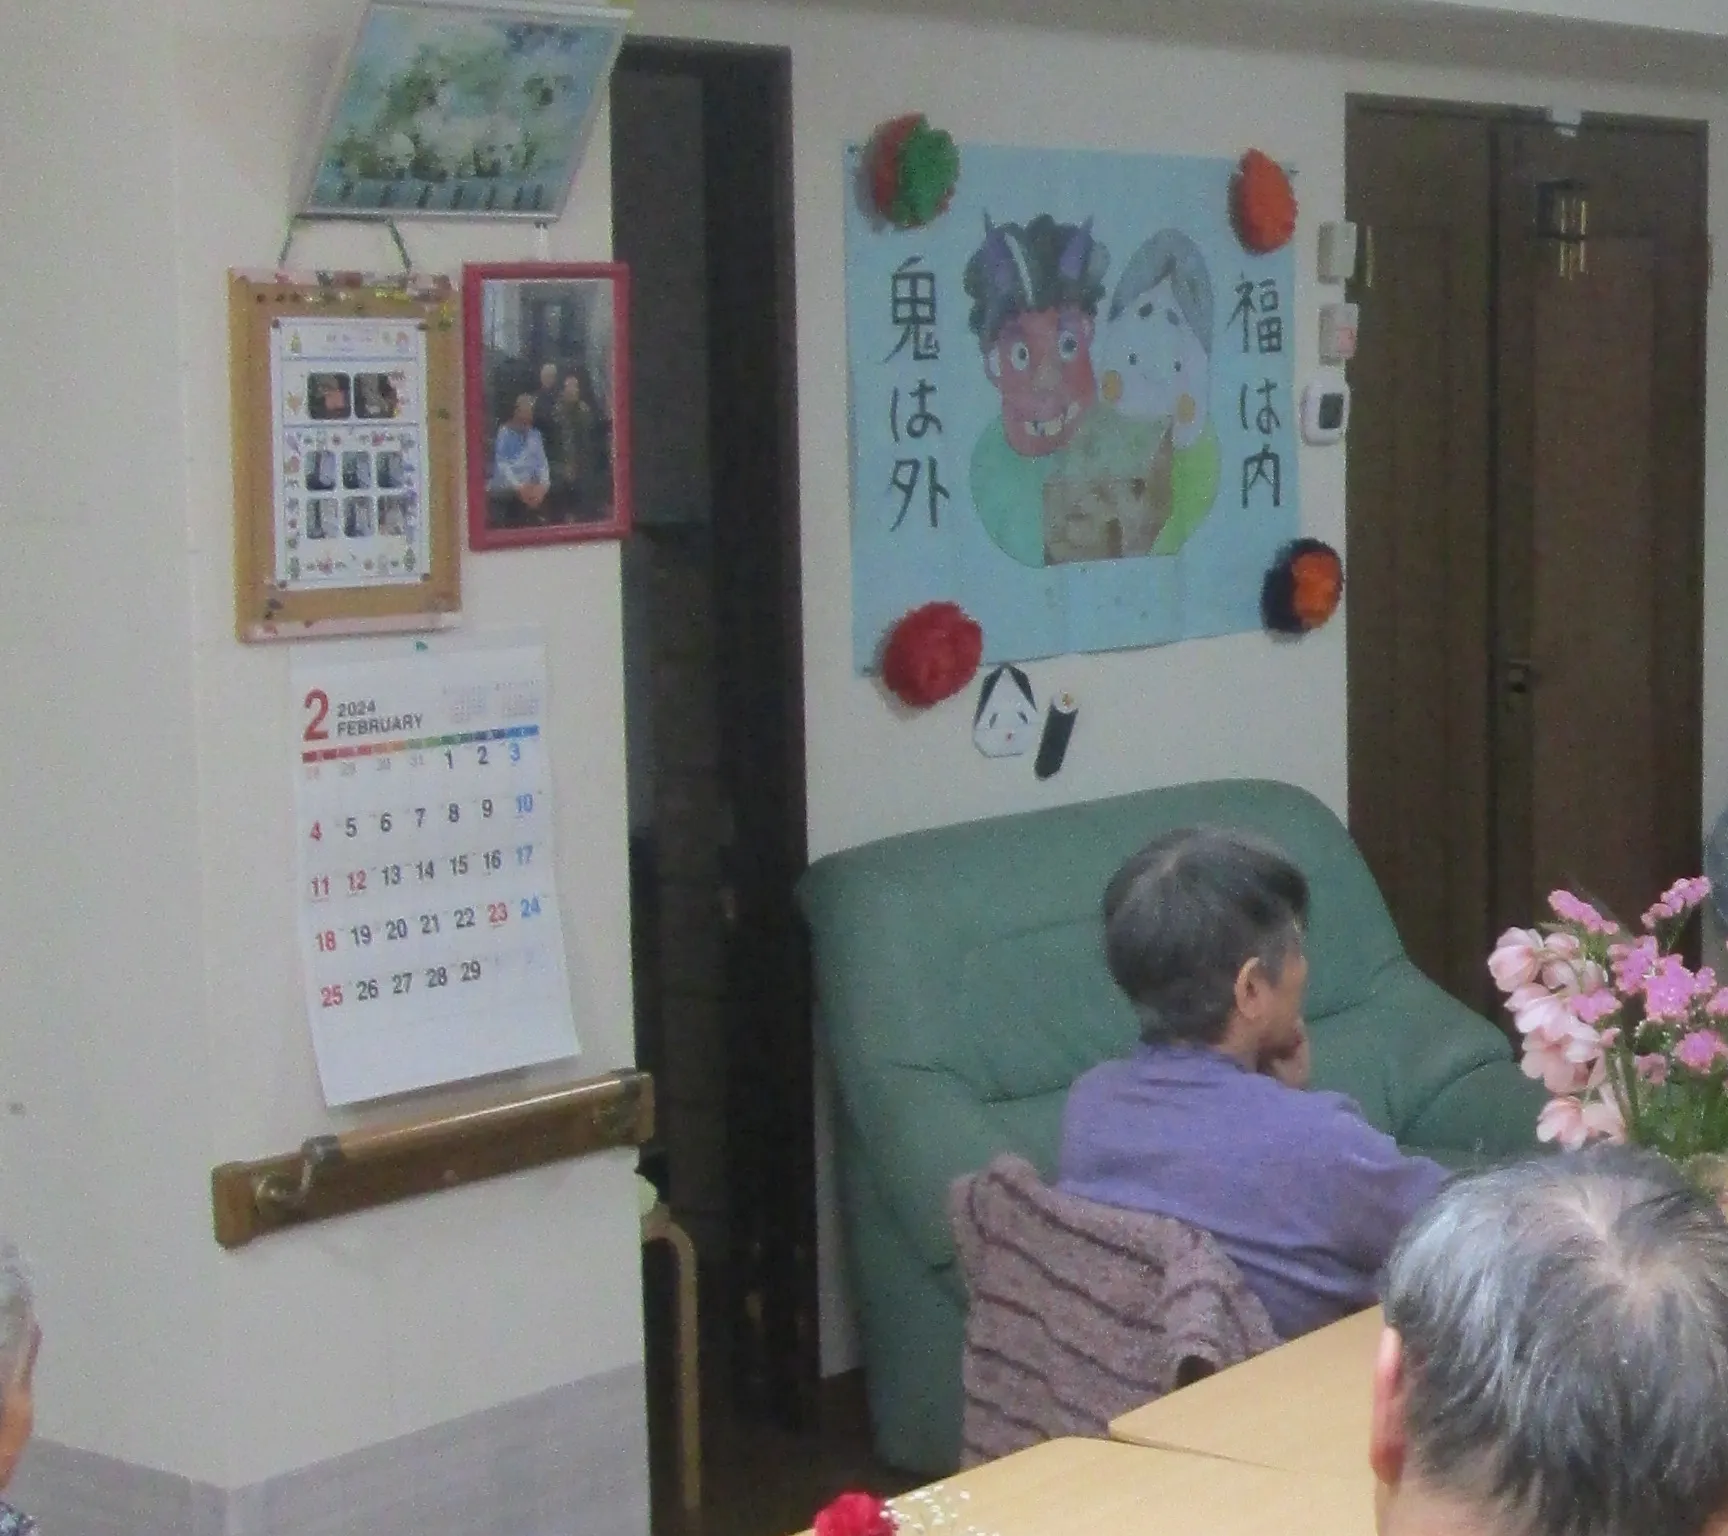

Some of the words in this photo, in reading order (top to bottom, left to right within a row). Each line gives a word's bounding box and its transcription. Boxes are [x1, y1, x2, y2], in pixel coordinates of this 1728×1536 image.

[883, 254, 950, 533] 鬼は外
[1226, 270, 1283, 509] 福は内
[303, 688, 329, 741] 2
[336, 700, 376, 717] 2024
[336, 713, 423, 738] FEBRUARY
[445, 747, 454, 769] 1
[477, 745, 489, 765] 2
[509, 742, 521, 762] 3
[310, 820, 322, 841] 4
[345, 816, 357, 838] 5
[380, 811, 392, 832] 6
[415, 807, 426, 828] 7
[449, 802, 460, 823] 8
[482, 798, 493, 818] 9
[516, 793, 533, 814] 10
[311, 874, 330, 896] 11
[347, 869, 367, 891] 12
[382, 864, 401, 887] 13
[416, 859, 434, 881] 14
[450, 853, 468, 875] 15
[482, 849, 501, 870] 16
[516, 844, 533, 865] 17
[315, 929, 336, 952] 18
[351, 924, 372, 947] 19
[385, 918, 408, 941] 20
[420, 913, 440, 934] 21
[453, 906, 475, 928] 22
[487, 901, 508, 924] 23
[521, 894, 541, 918] 24
[320, 983, 343, 1007] 25
[356, 978, 378, 1001] 26
[392, 971, 413, 994] 27
[425, 965, 447, 988] 28
[460, 960, 481, 983] 29
